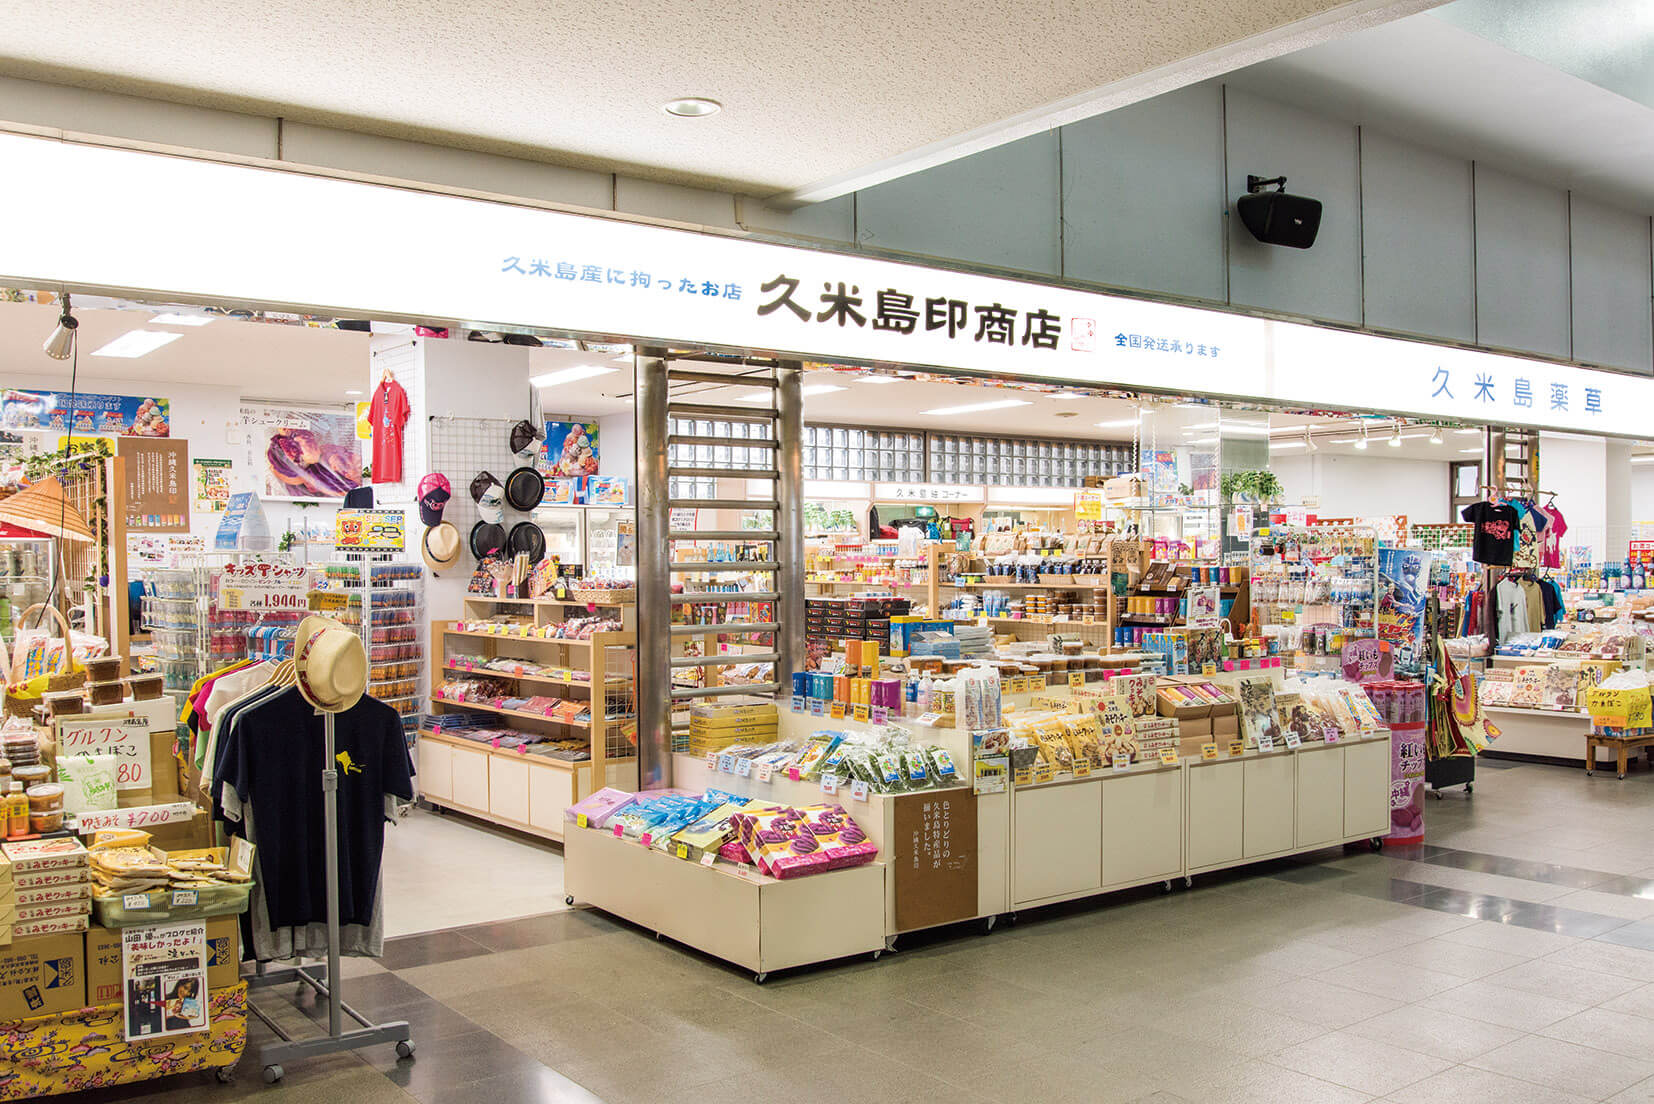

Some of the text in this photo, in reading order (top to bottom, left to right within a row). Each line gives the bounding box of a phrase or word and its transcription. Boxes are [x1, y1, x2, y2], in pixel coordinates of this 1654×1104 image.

[501, 256, 743, 300] 久米島産に拘ったお店
[757, 274, 1061, 350] 久米島印商店
[1114, 332, 1221, 358] 全国発送承ります
[1431, 365, 1603, 414] 久米島薬草
[128, 810, 170, 827] ¥700
[932, 802, 941, 869] 久米島特産品が
[942, 800, 951, 858] 色とりどりの
